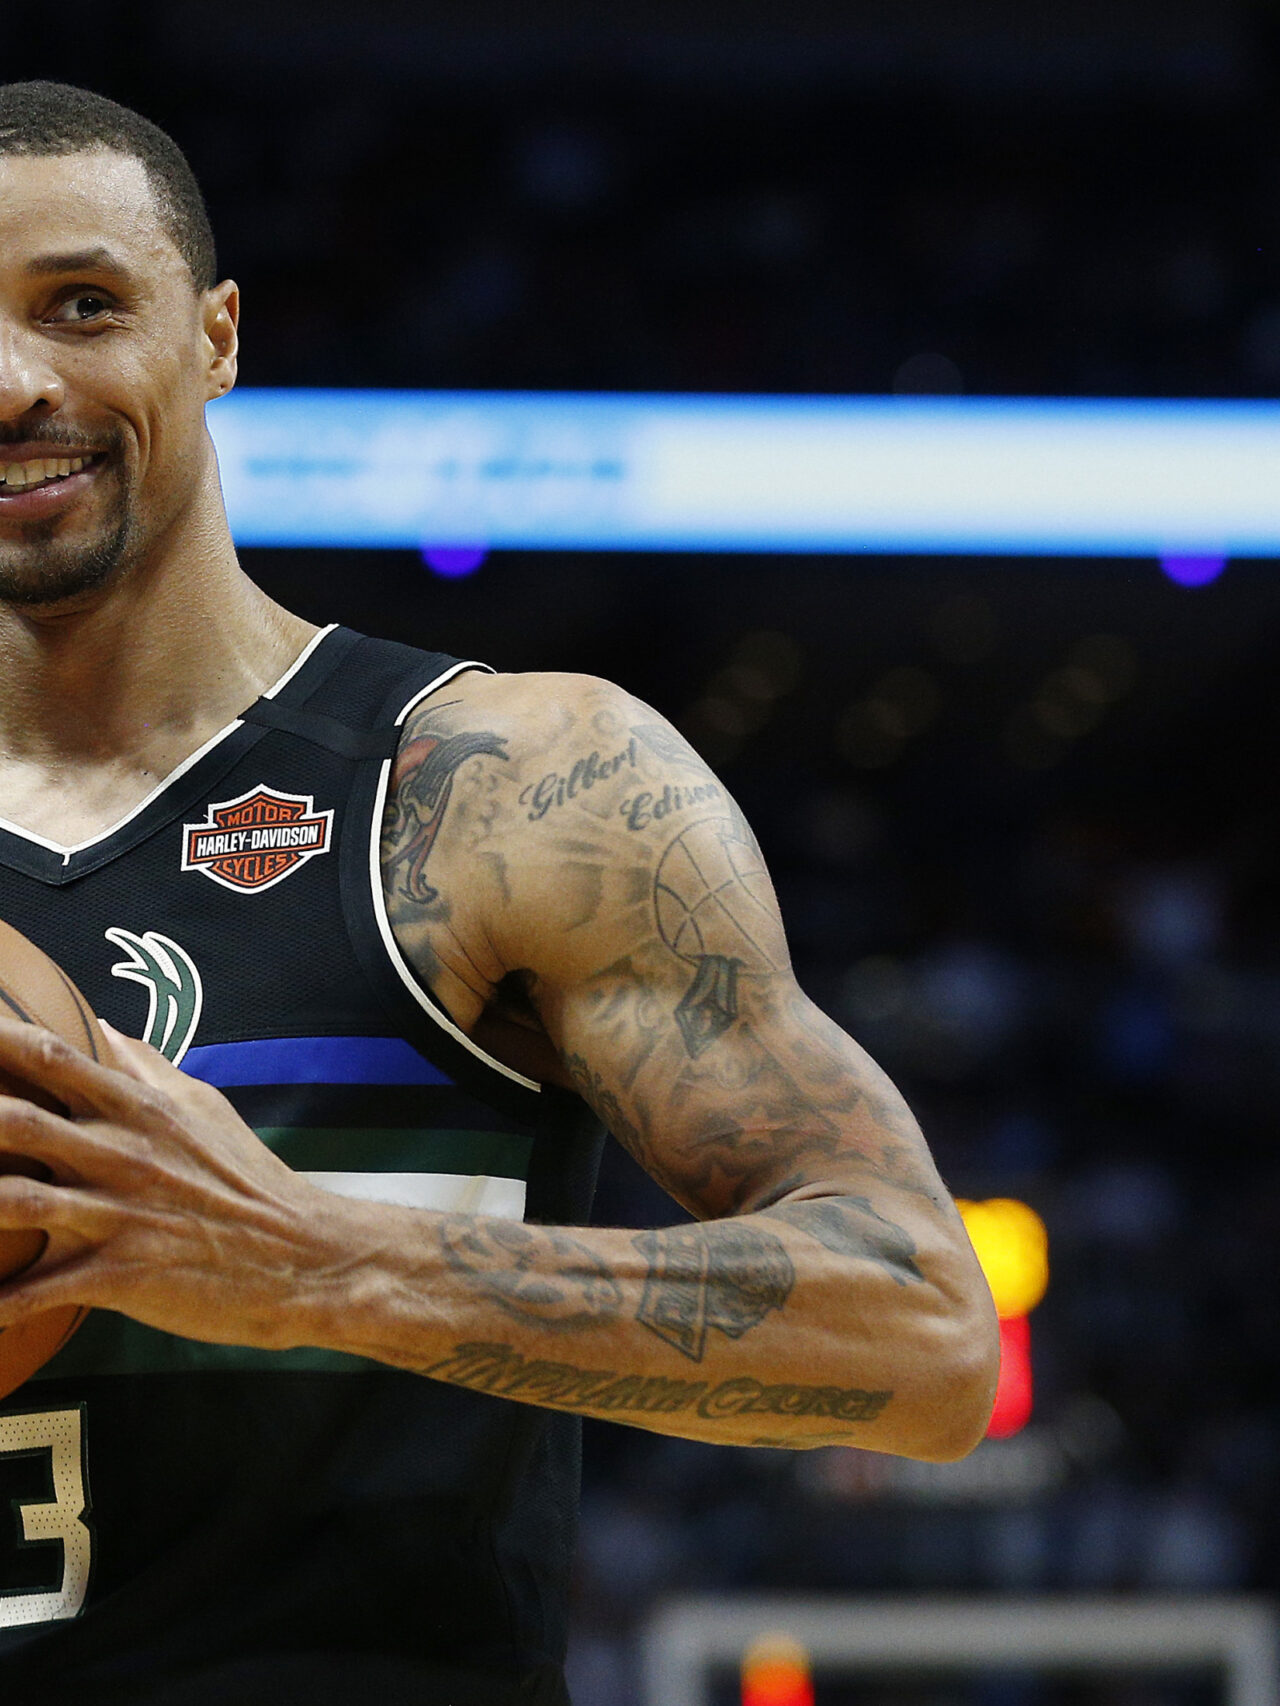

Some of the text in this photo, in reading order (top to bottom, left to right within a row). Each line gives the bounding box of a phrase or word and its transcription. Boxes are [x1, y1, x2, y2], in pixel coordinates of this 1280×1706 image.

[519, 737, 638, 822] Gilbert
[226, 801, 293, 827] MOTOR
[620, 783, 721, 831] Edison
[196, 825, 319, 858] HARLEY-DAVIDSON
[222, 853, 288, 882] CYCLES
